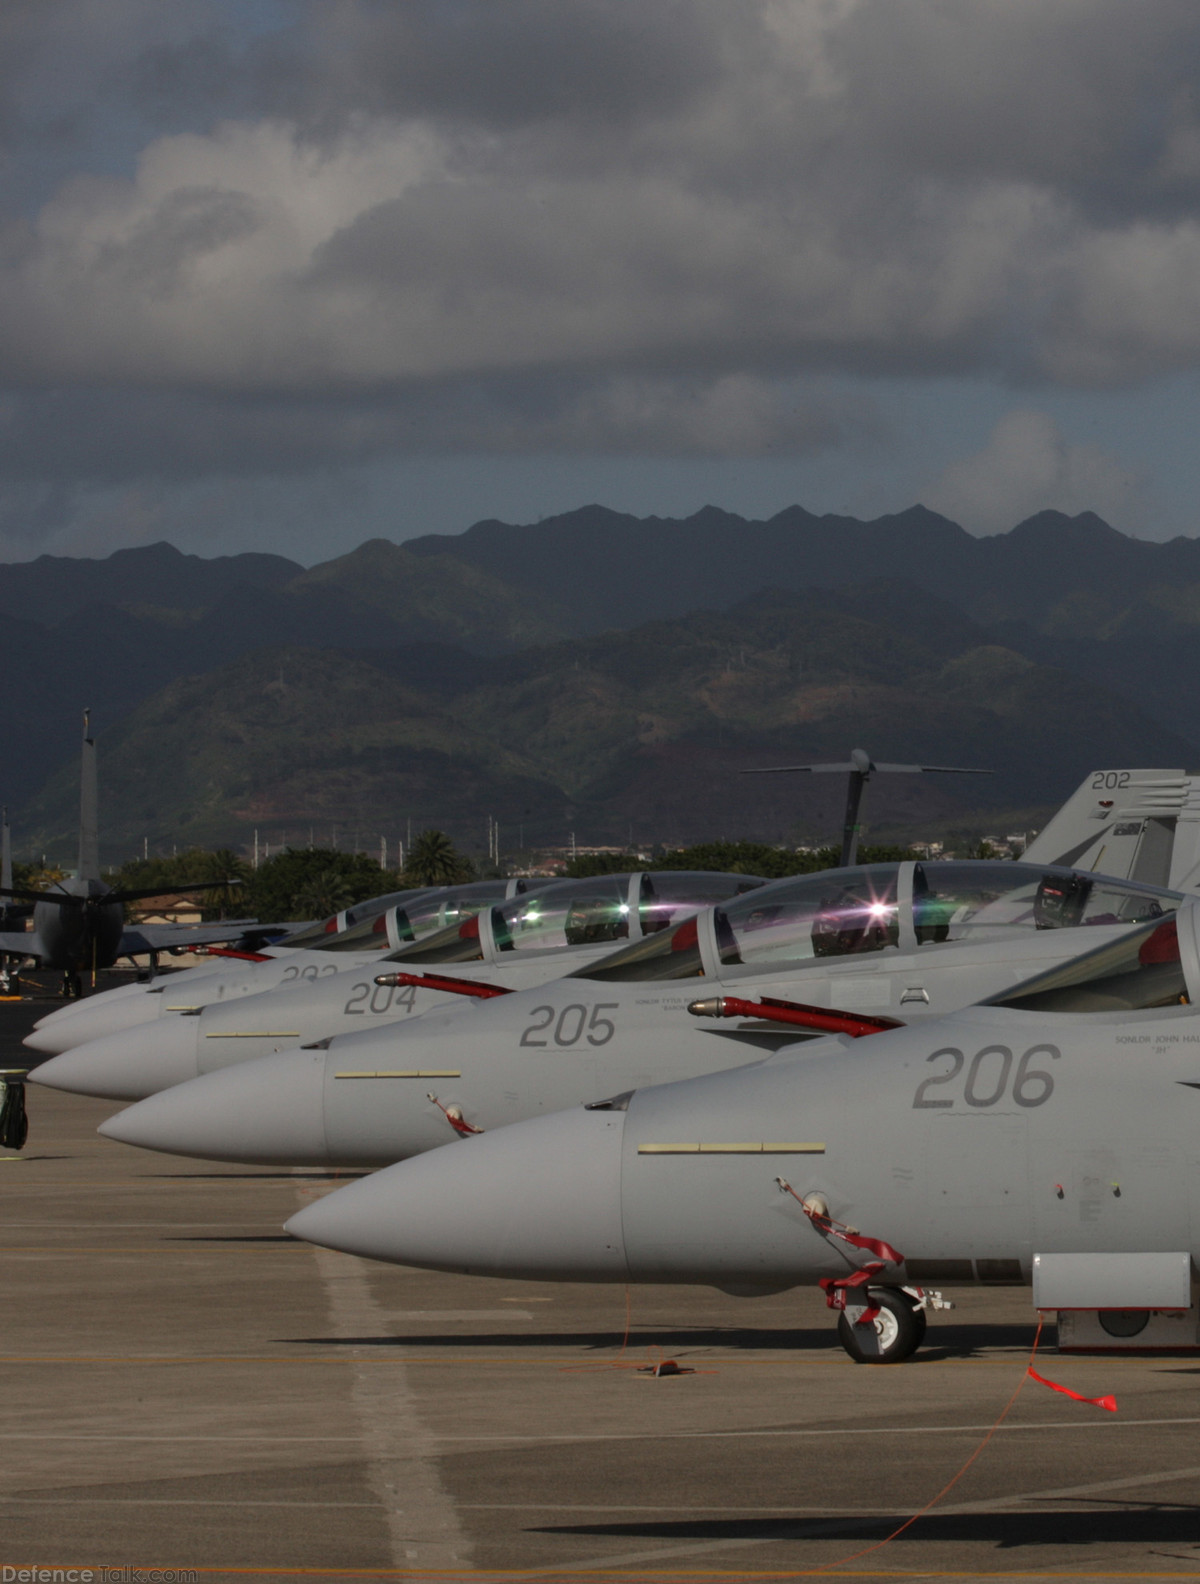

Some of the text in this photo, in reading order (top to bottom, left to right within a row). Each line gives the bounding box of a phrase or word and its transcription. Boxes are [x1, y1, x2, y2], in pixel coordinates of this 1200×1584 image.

[1092, 772, 1130, 790] 202
[519, 1003, 620, 1047] 205
[1155, 1035, 1179, 1044] JOHN
[912, 1044, 1062, 1109] 206
